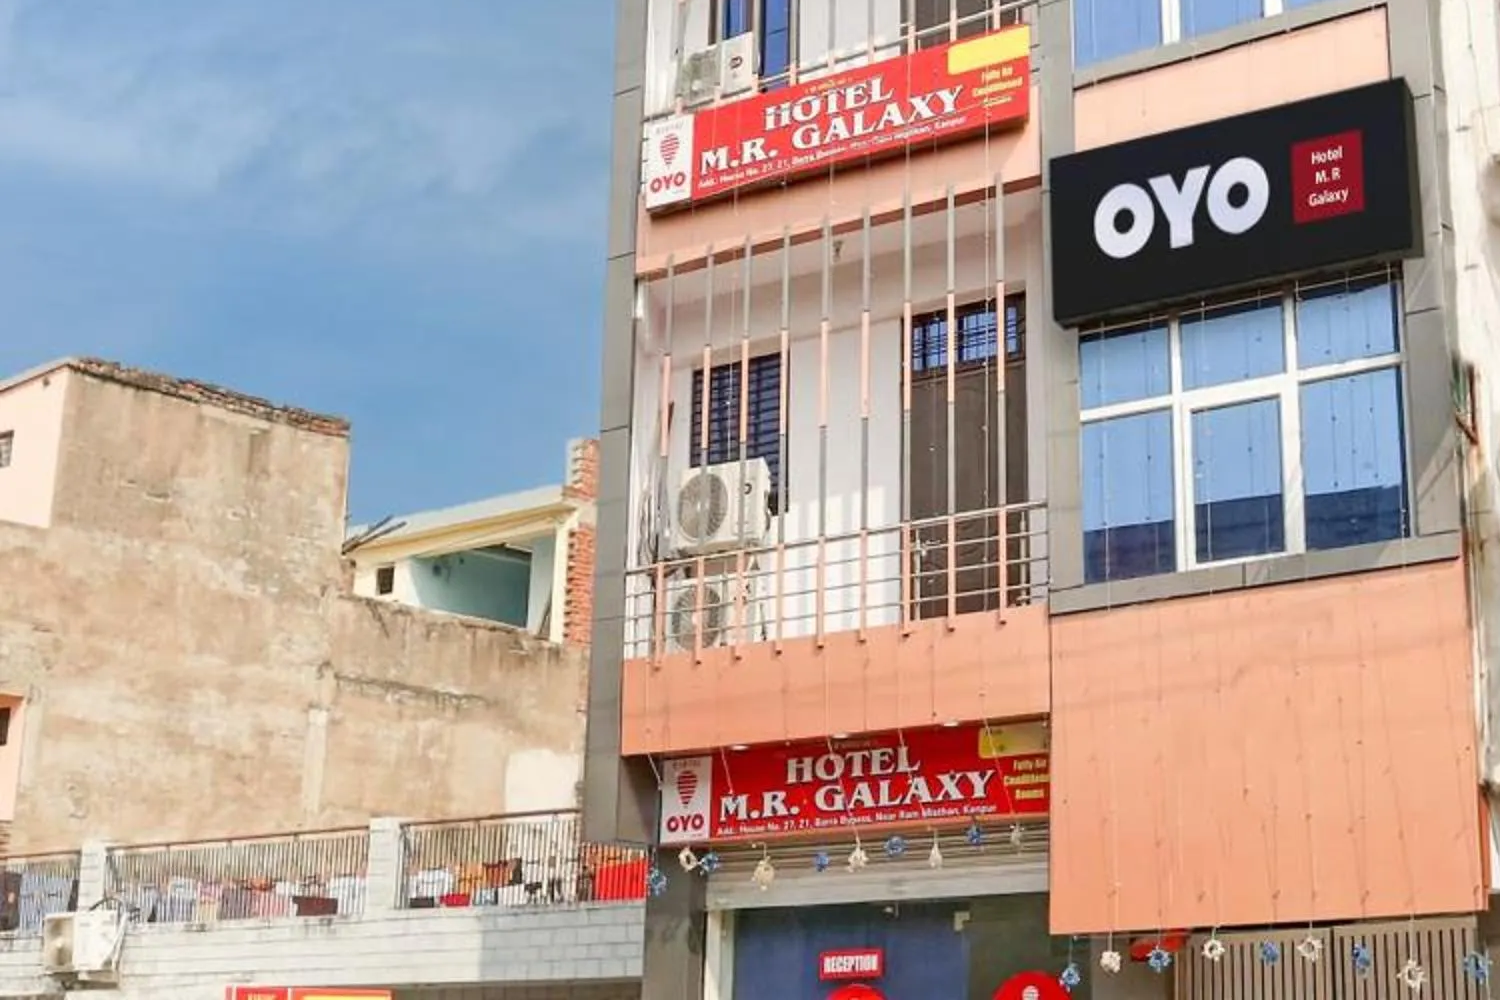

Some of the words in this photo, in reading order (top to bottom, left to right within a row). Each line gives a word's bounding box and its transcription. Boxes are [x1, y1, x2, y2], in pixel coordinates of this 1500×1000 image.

[764, 76, 895, 131] HOTEL
[700, 137, 779, 175] M.R.
[791, 84, 964, 150] GALAXY
[1311, 145, 1343, 165] Hotel
[650, 171, 687, 194] OYO
[1308, 187, 1349, 207] Galaxy
[1093, 156, 1270, 259] OYO
[786, 746, 920, 784] HOTEL
[720, 790, 800, 822] M.R.
[815, 769, 994, 812] GALAXY
[666, 813, 704, 833] OYO
[823, 953, 879, 974] RECEPTION
